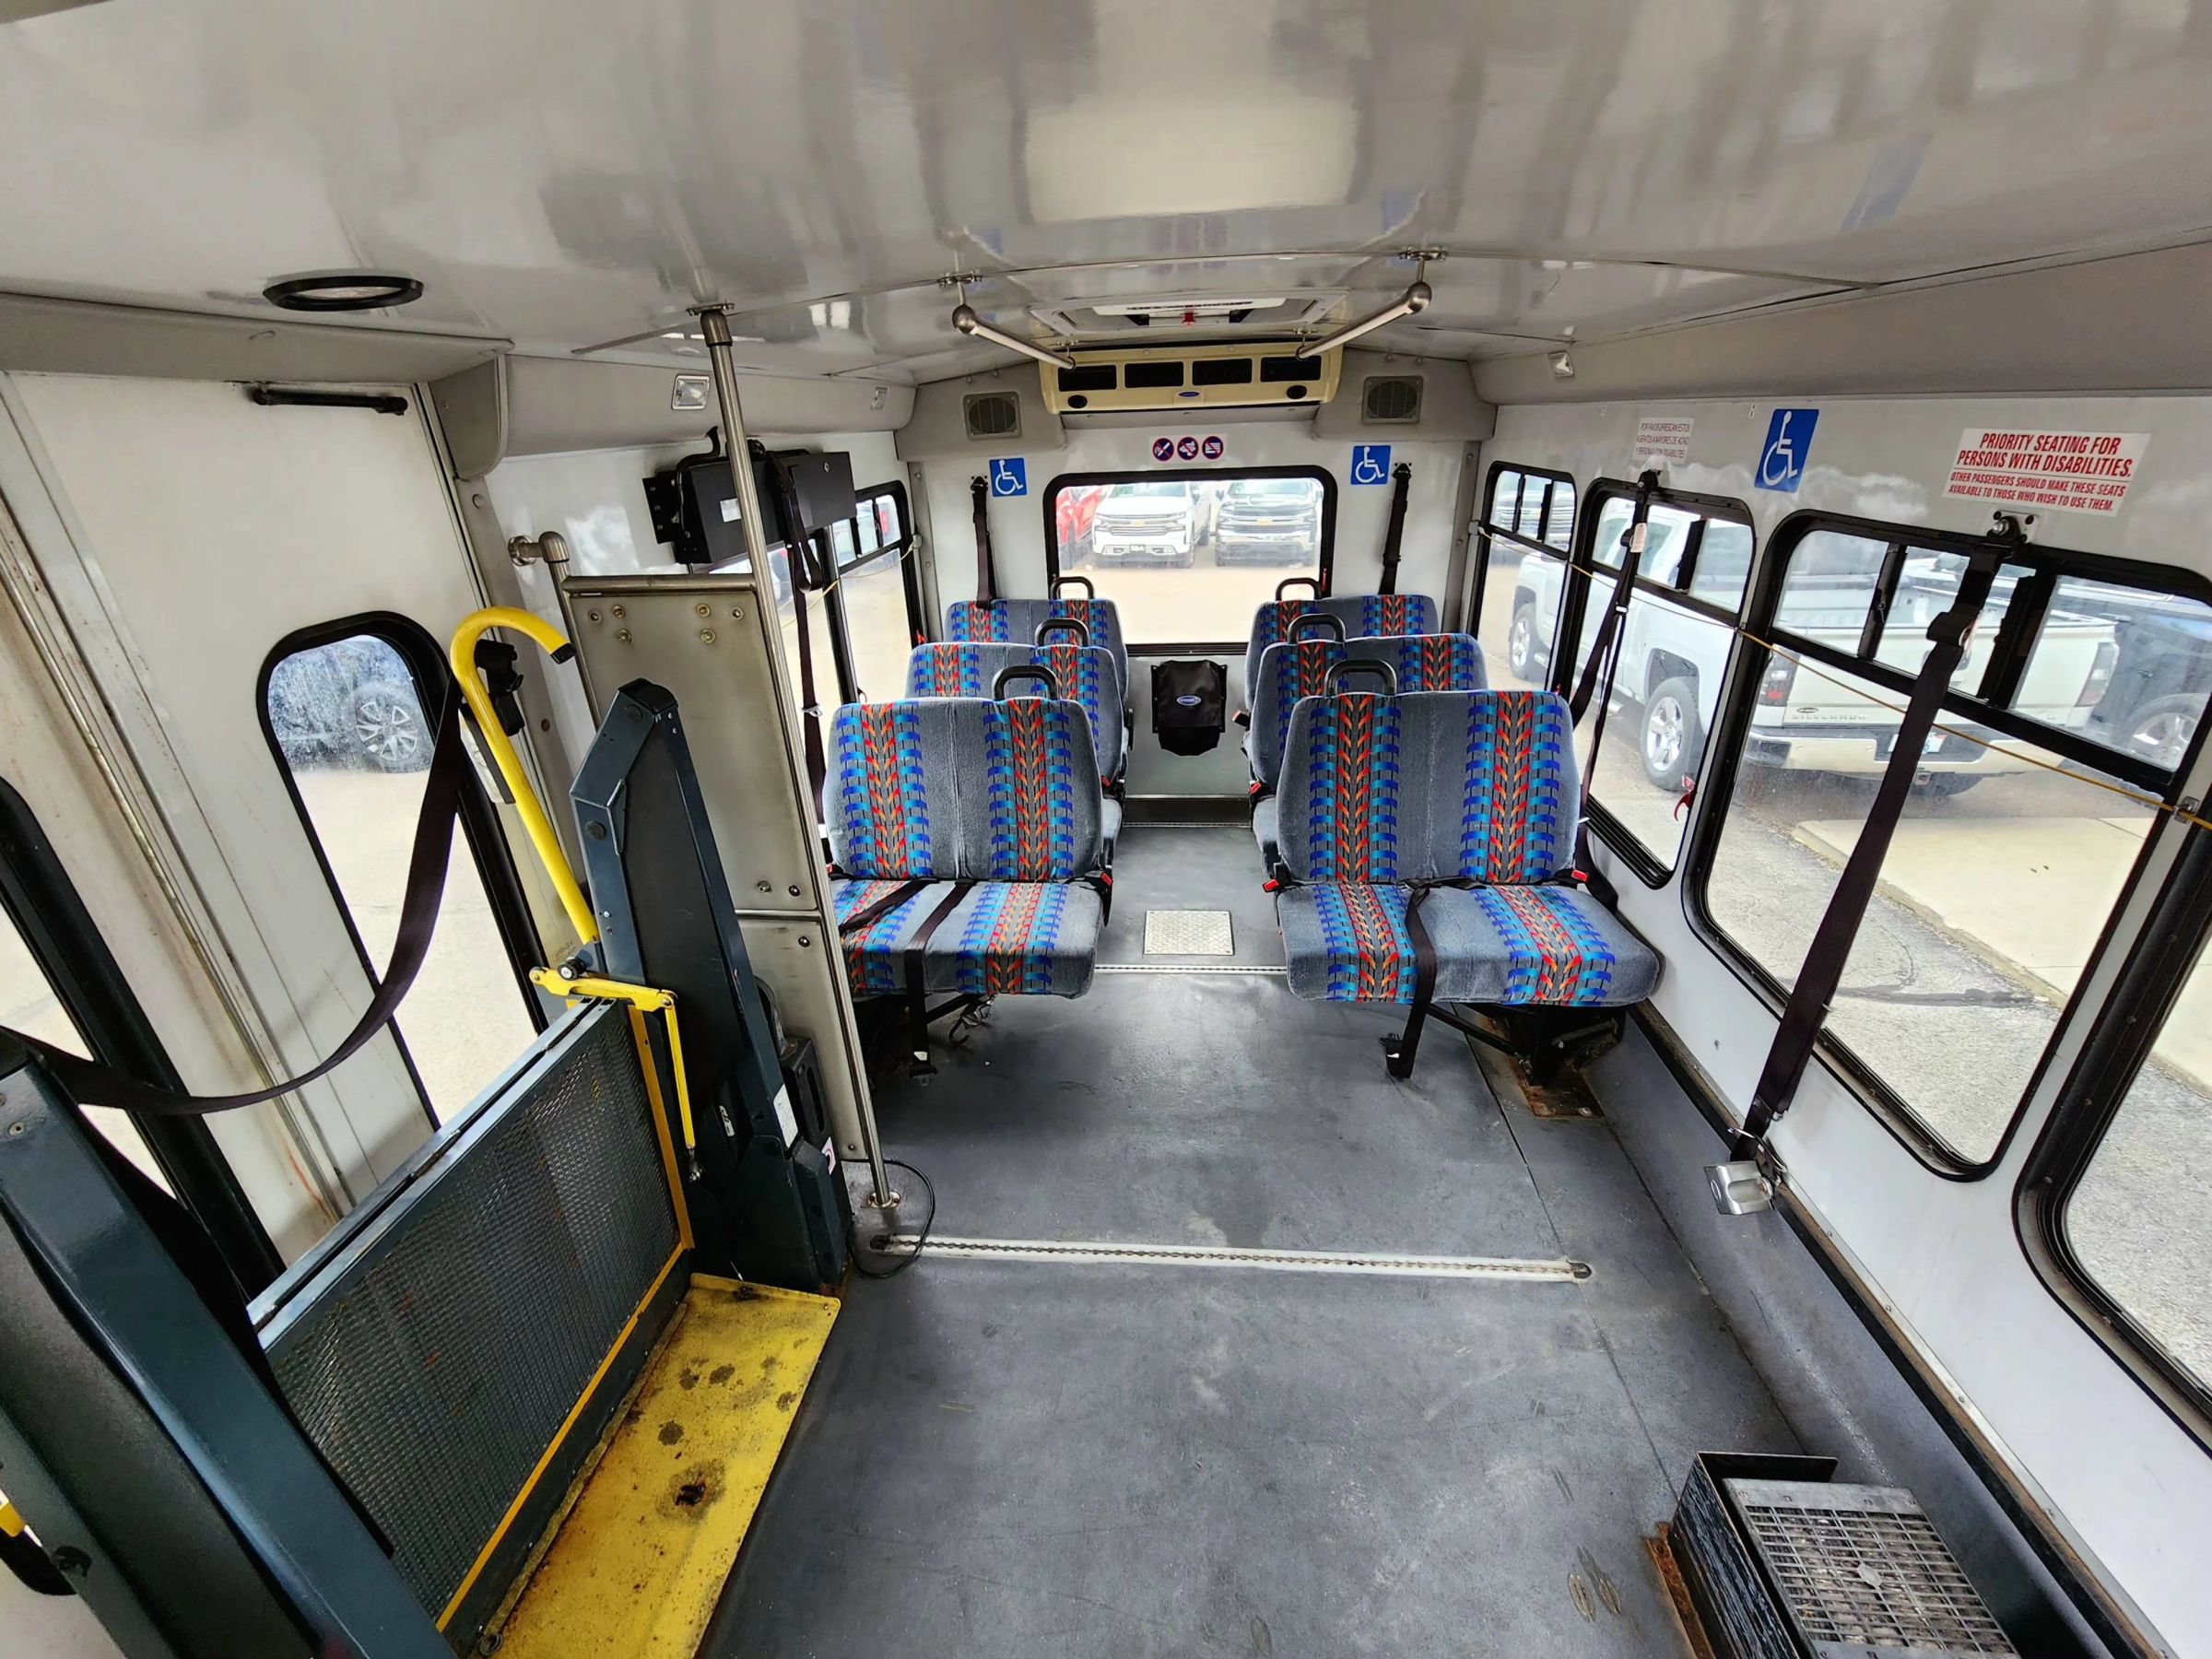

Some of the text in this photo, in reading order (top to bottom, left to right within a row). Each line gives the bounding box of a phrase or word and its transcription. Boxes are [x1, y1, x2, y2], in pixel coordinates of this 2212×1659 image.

[1980, 433, 2122, 455] PRIORITY SEATING FOR
[1957, 450, 2133, 477] PERSONS WITH DISABILITIES.
[1950, 472, 2125, 497] OTHER PASSENGERS SHOULD MAKE THESE SEATS
[1948, 485, 2113, 512] AVAILABLE TO THOSE WHO WISH TO USE THEM.
